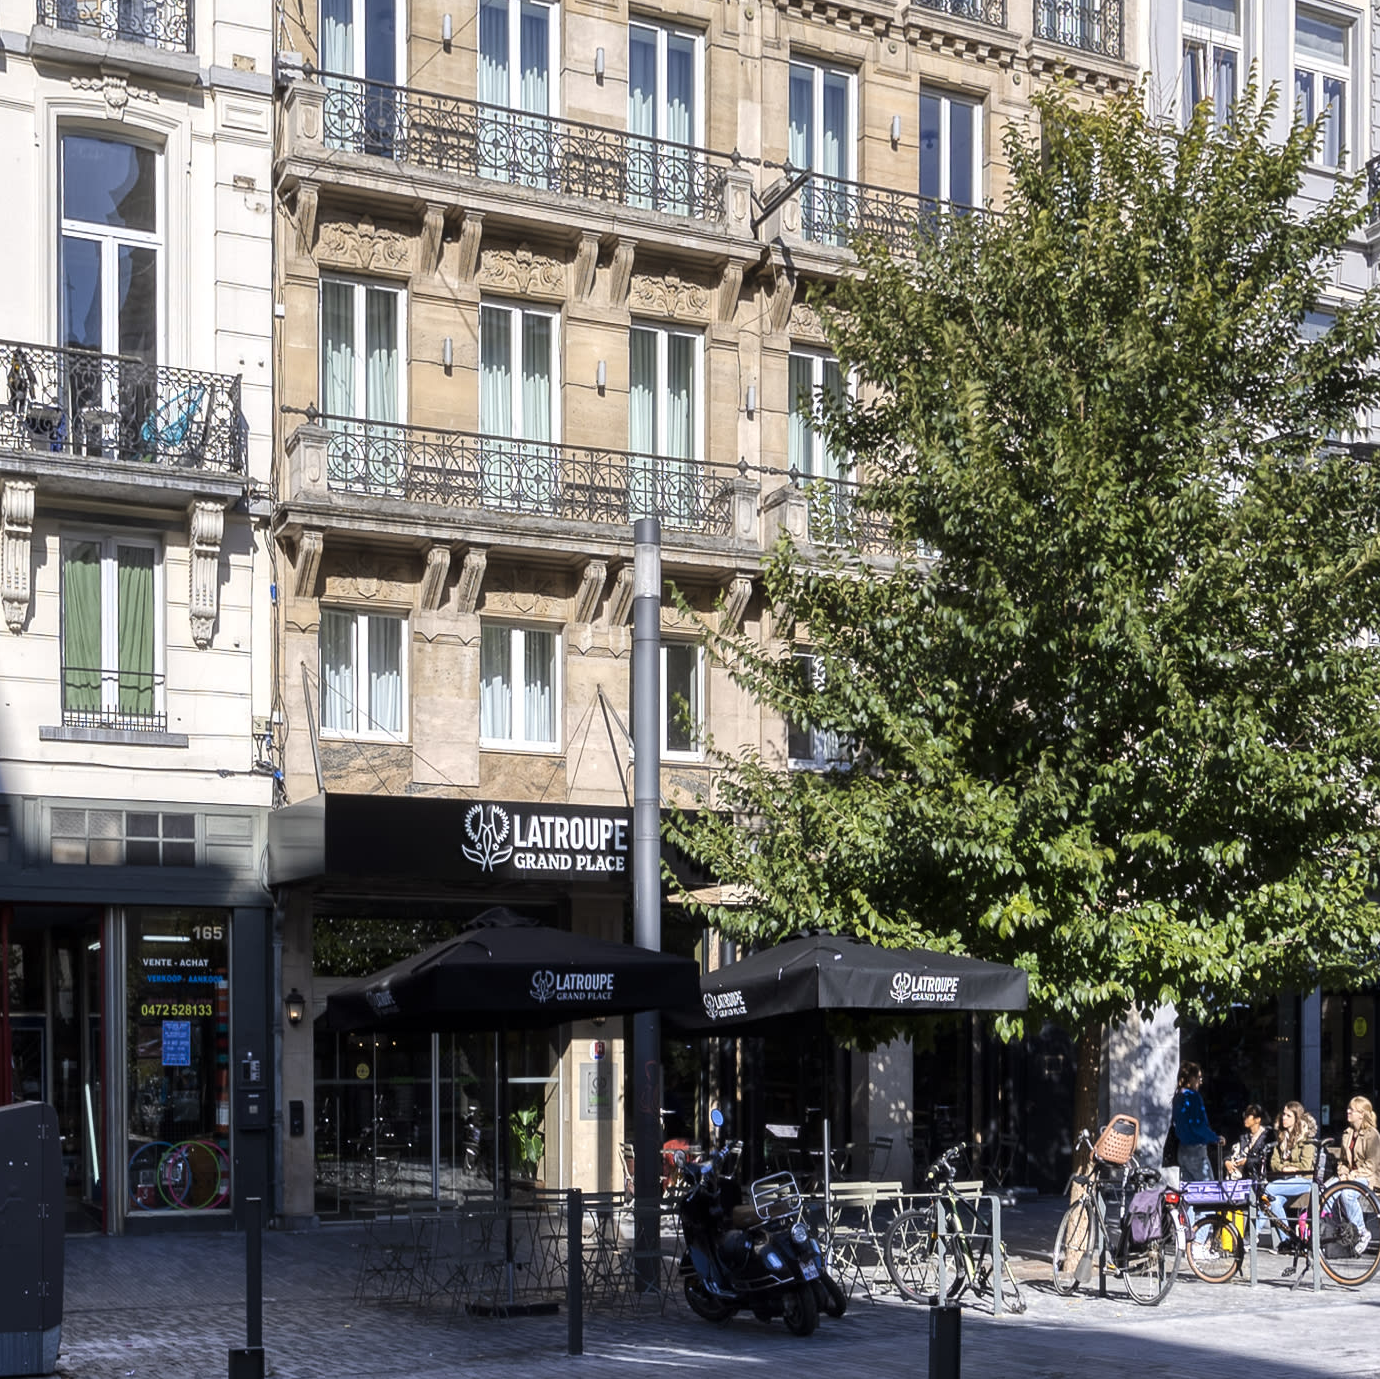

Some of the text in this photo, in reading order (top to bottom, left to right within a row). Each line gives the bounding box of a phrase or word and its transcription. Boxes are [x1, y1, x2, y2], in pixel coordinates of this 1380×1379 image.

[513, 814, 629, 851] LATROUPE
[513, 853, 626, 871] GRAND PLACE
[192, 926, 223, 940] 165
[142, 957, 173, 967] VENTE
[179, 958, 210, 967] ACHAT
[556, 972, 615, 991] LATROUPE
[911, 974, 960, 995] LATROUPE
[556, 990, 613, 1001] GRAND PLACE
[713, 990, 745, 1010] LATROUPE
[911, 992, 956, 1003] GRAND PLACE
